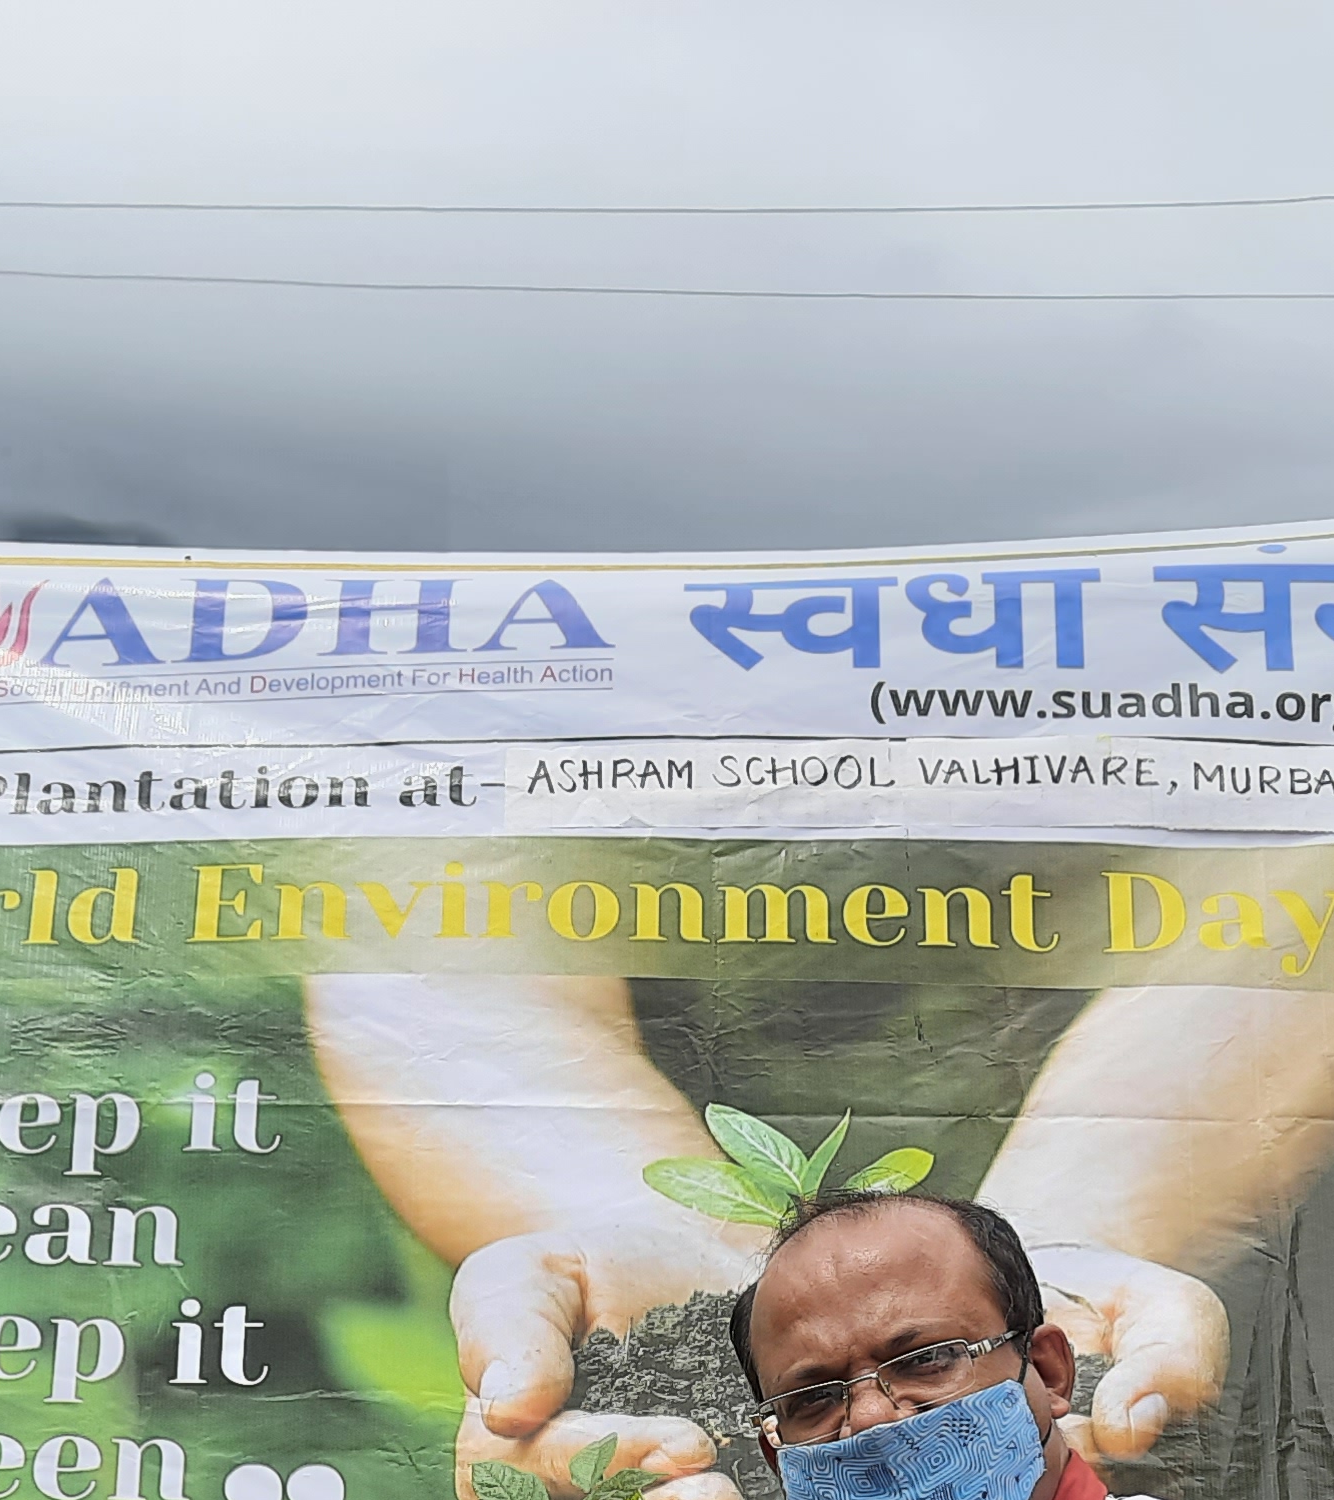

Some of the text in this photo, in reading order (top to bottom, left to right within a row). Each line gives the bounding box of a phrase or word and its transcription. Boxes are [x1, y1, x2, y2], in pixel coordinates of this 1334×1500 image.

[683, 570, 1100, 672] स्वधा
[195, 676, 241, 697] And
[250, 668, 403, 695] Development
[412, 668, 451, 687] For
[458, 665, 533, 686] Health
[540, 664, 614, 684] Action
[527, 757, 695, 795] ASHRAM
[712, 754, 896, 789] SCHOOL
[185, 861, 1061, 953] Environment
[182, 1072, 282, 1155] it
[168, 1298, 269, 1387] it
